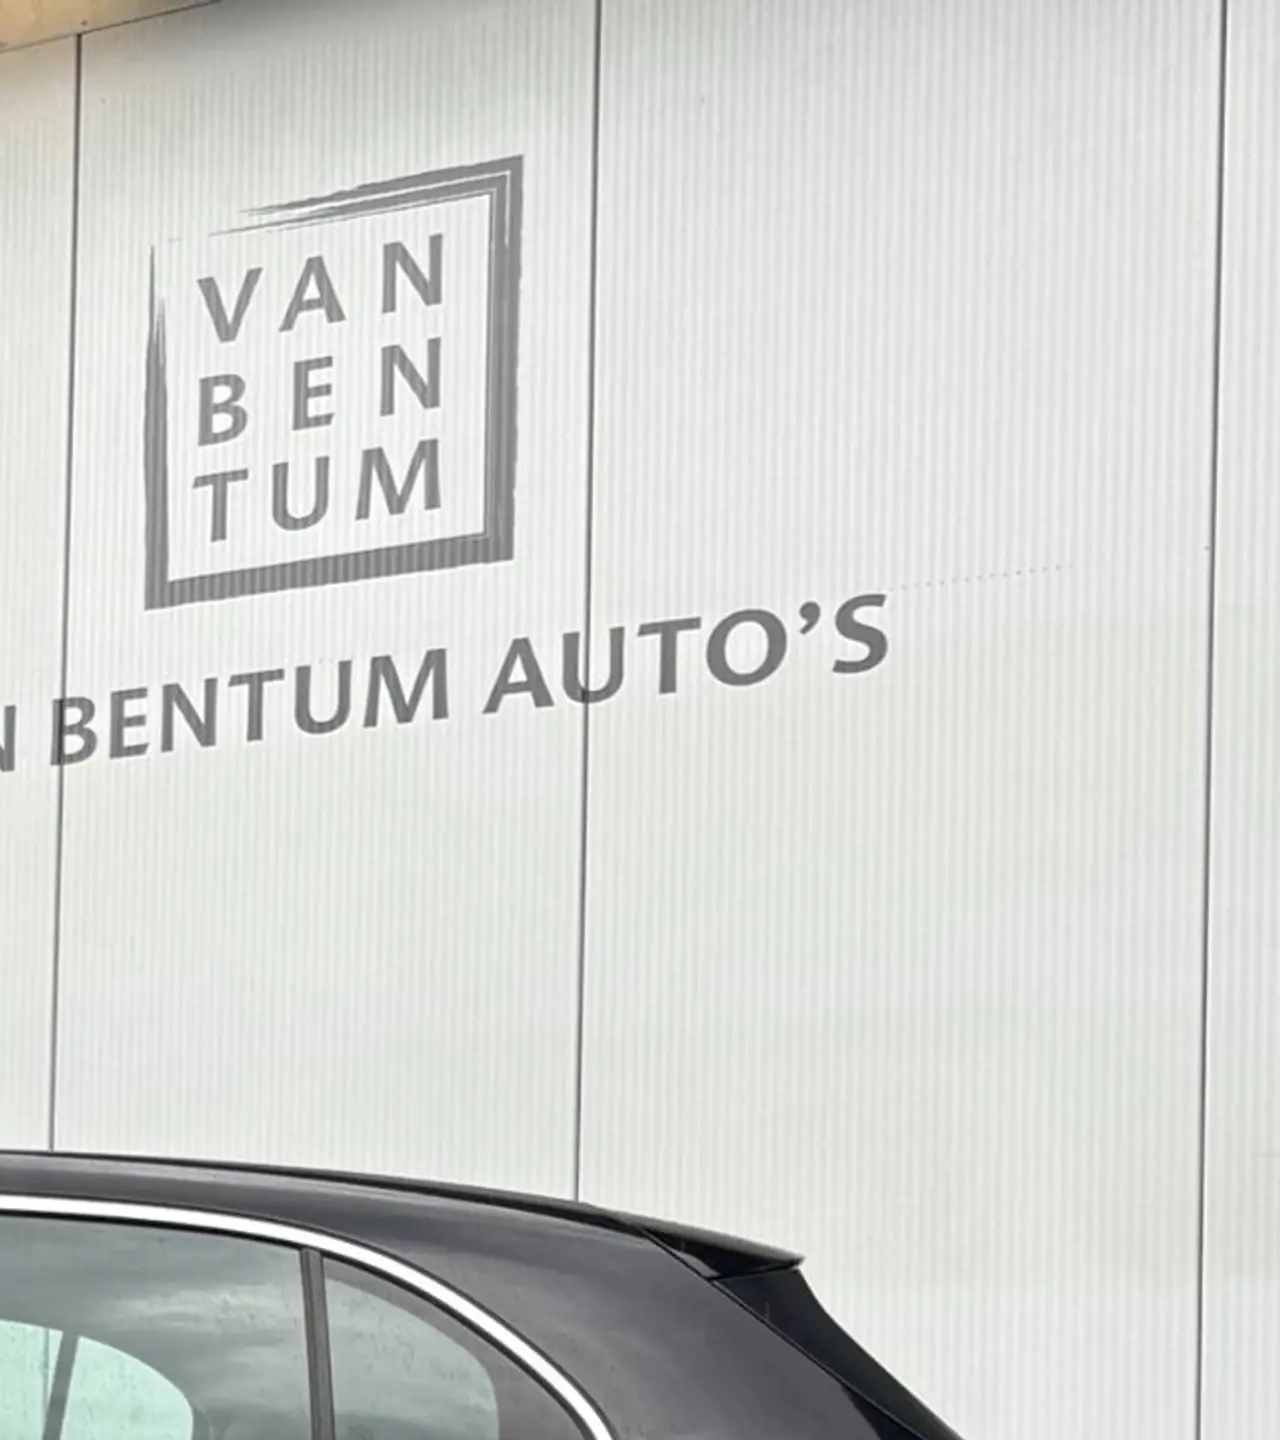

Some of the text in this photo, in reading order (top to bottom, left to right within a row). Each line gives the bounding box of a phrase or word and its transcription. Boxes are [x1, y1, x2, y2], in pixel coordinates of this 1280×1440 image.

[197, 233, 444, 343] VAN
[197, 337, 443, 446] BEN
[191, 438, 443, 542] TUM
[49, 648, 450, 768] BENTUM
[482, 593, 889, 715] AUTO’S
